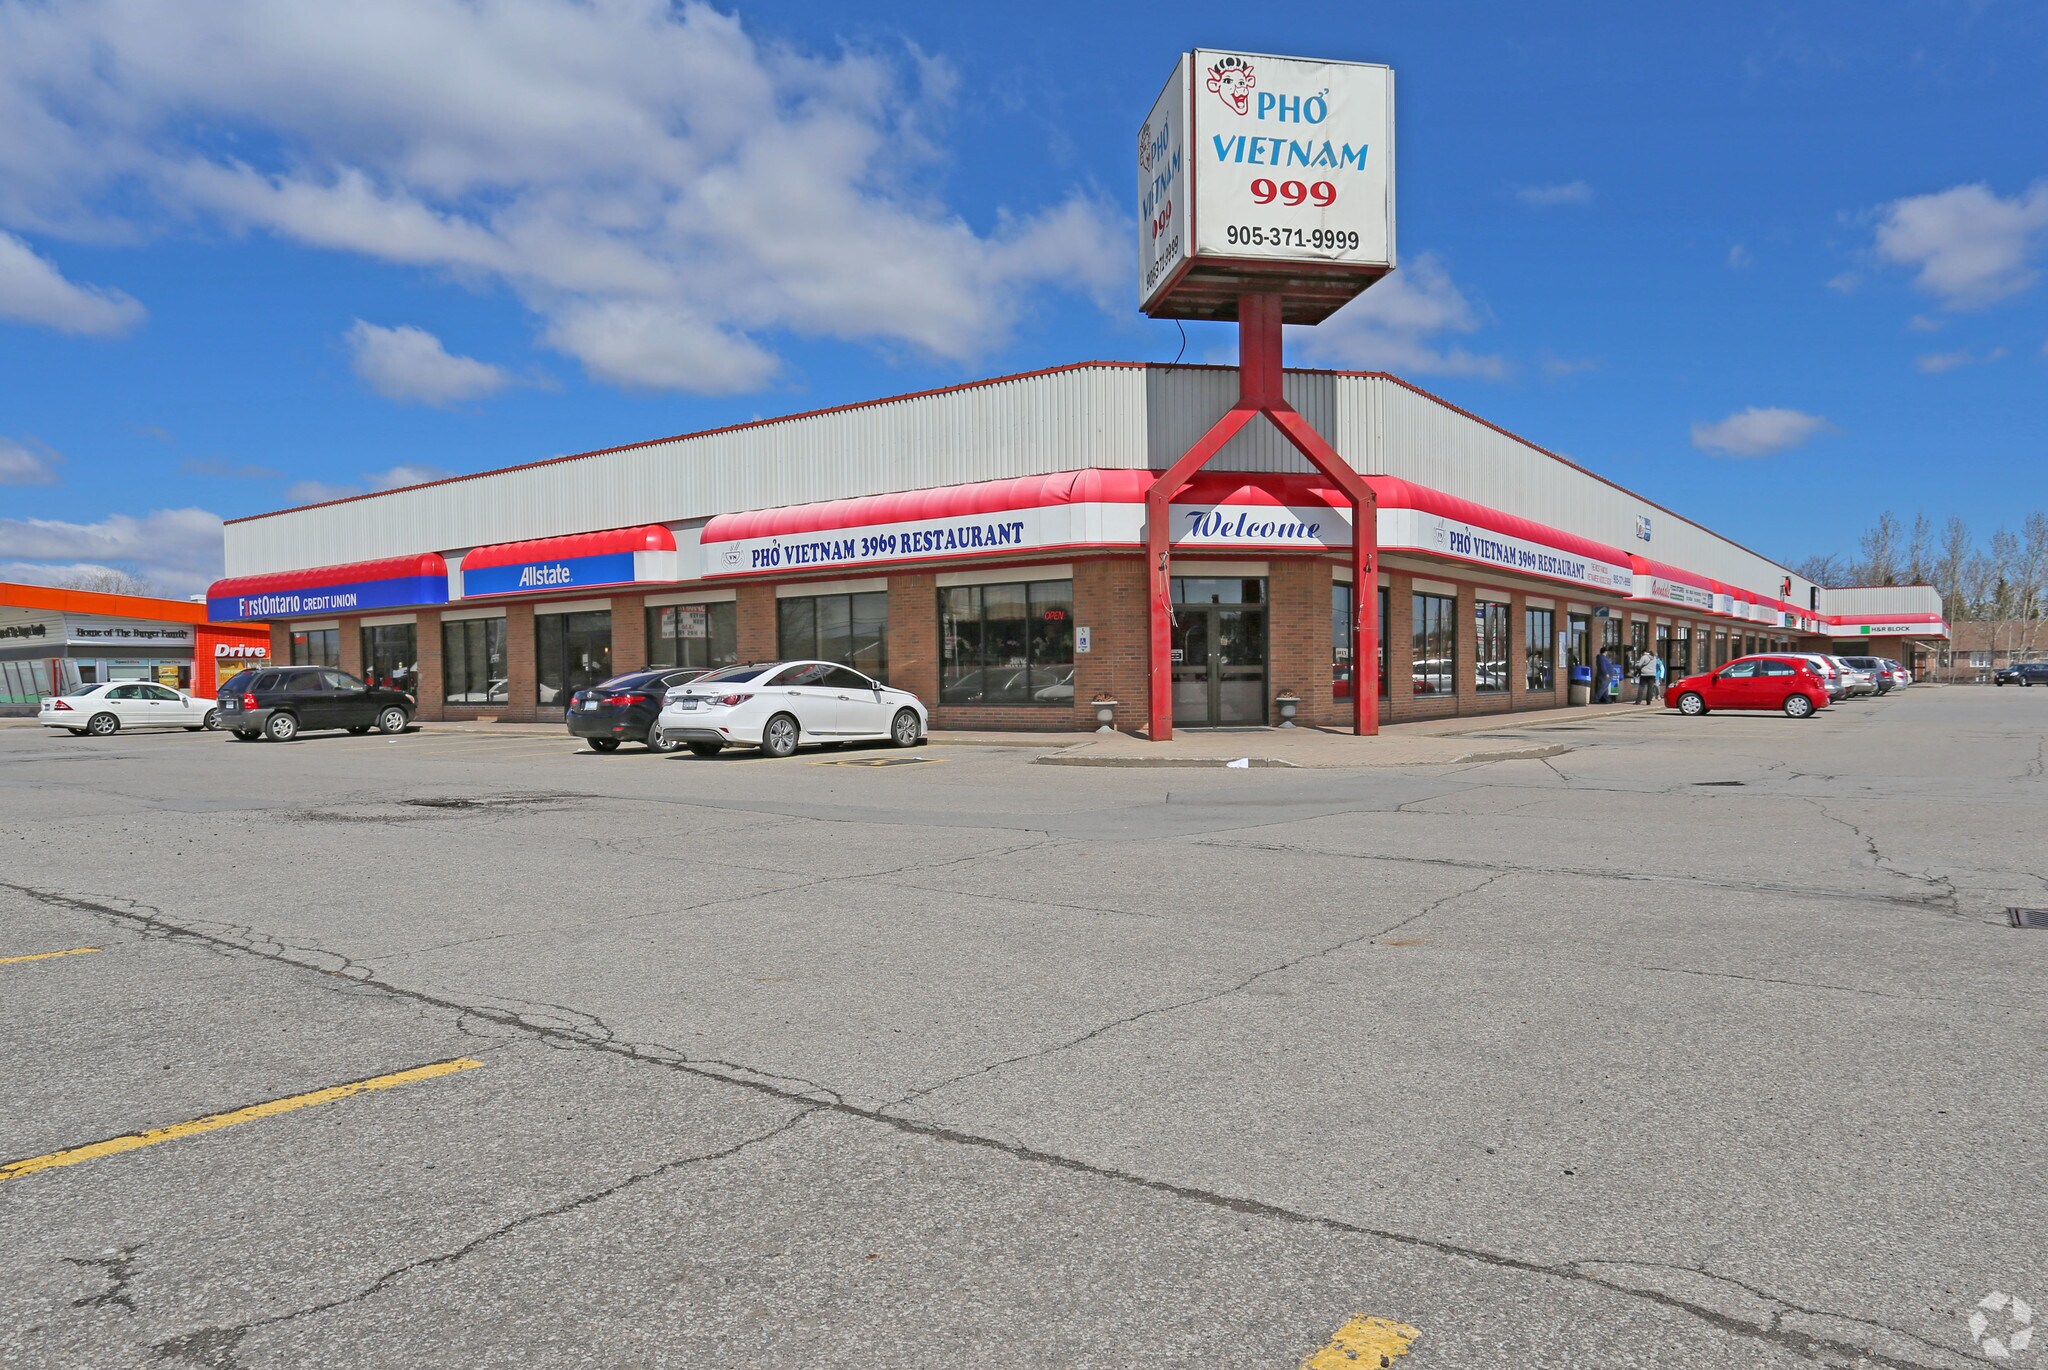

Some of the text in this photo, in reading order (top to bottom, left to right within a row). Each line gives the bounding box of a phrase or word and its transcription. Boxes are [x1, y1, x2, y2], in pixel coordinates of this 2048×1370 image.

[1212, 133, 1369, 171] VIETNAM
[1250, 178, 1337, 207] 999
[1226, 224, 1360, 250] 905-371-9999
[1184, 511, 1322, 539] Welcome
[784, 539, 856, 565] VIETNAM
[860, 534, 897, 557] 3969
[900, 521, 1025, 554] RESTAURANT
[1473, 537, 1517, 565] VIETNAM
[1518, 550, 1536, 569] 3969
[1538, 553, 1586, 580] RESTAURANT
[519, 564, 570, 587] Allstate
[302, 596, 331, 611] CREDIT
[330, 593, 357, 608] UNION
[1044, 611, 1065, 620] OPEN
[76, 627, 188, 639] Home of The Burger Family
[214, 643, 266, 658] Drive
